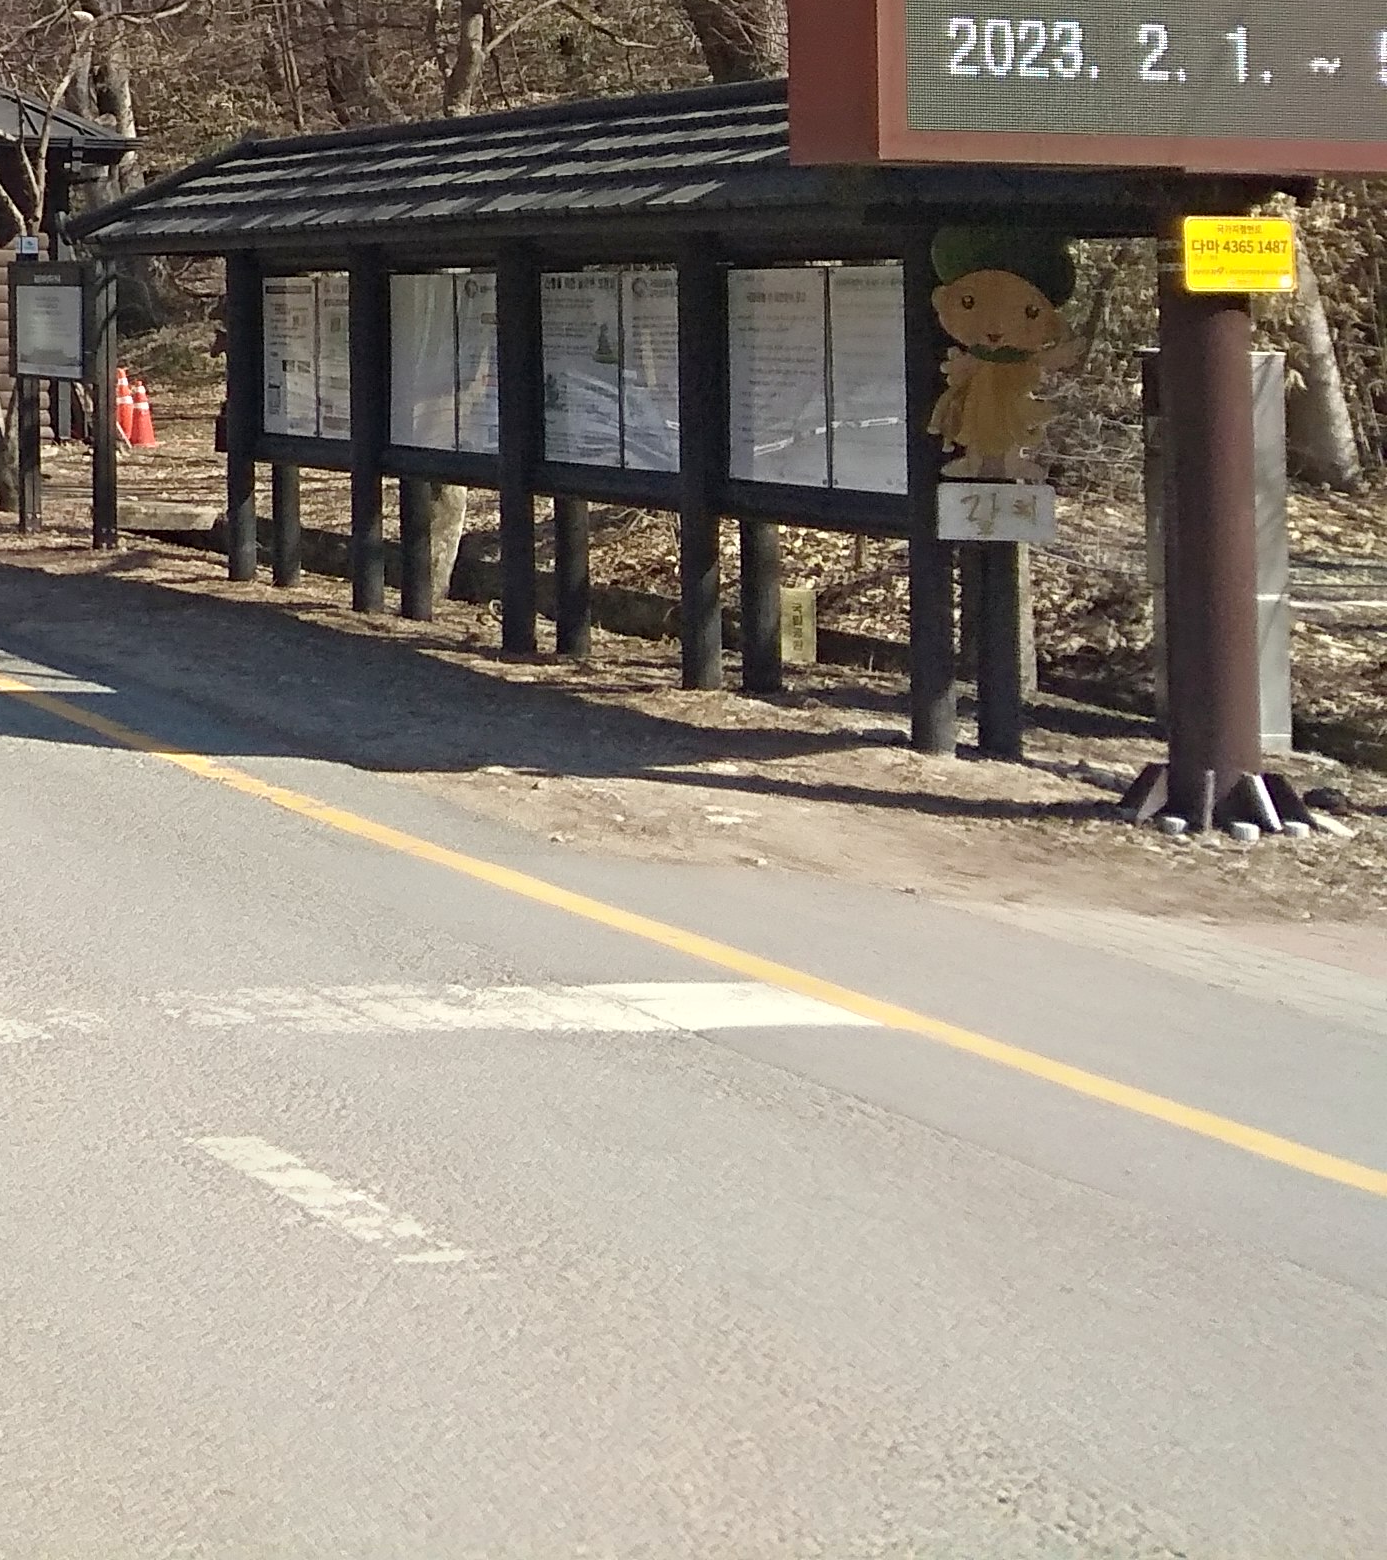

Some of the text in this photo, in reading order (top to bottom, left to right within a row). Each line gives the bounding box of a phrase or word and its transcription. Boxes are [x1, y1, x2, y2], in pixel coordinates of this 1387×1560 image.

[947, 16, 1100, 77] 2023.
[1138, 24, 1187, 83] 2.
[1225, 25, 1273, 84] 1.
[1192, 239, 1289, 254] 다마 4365 1487
